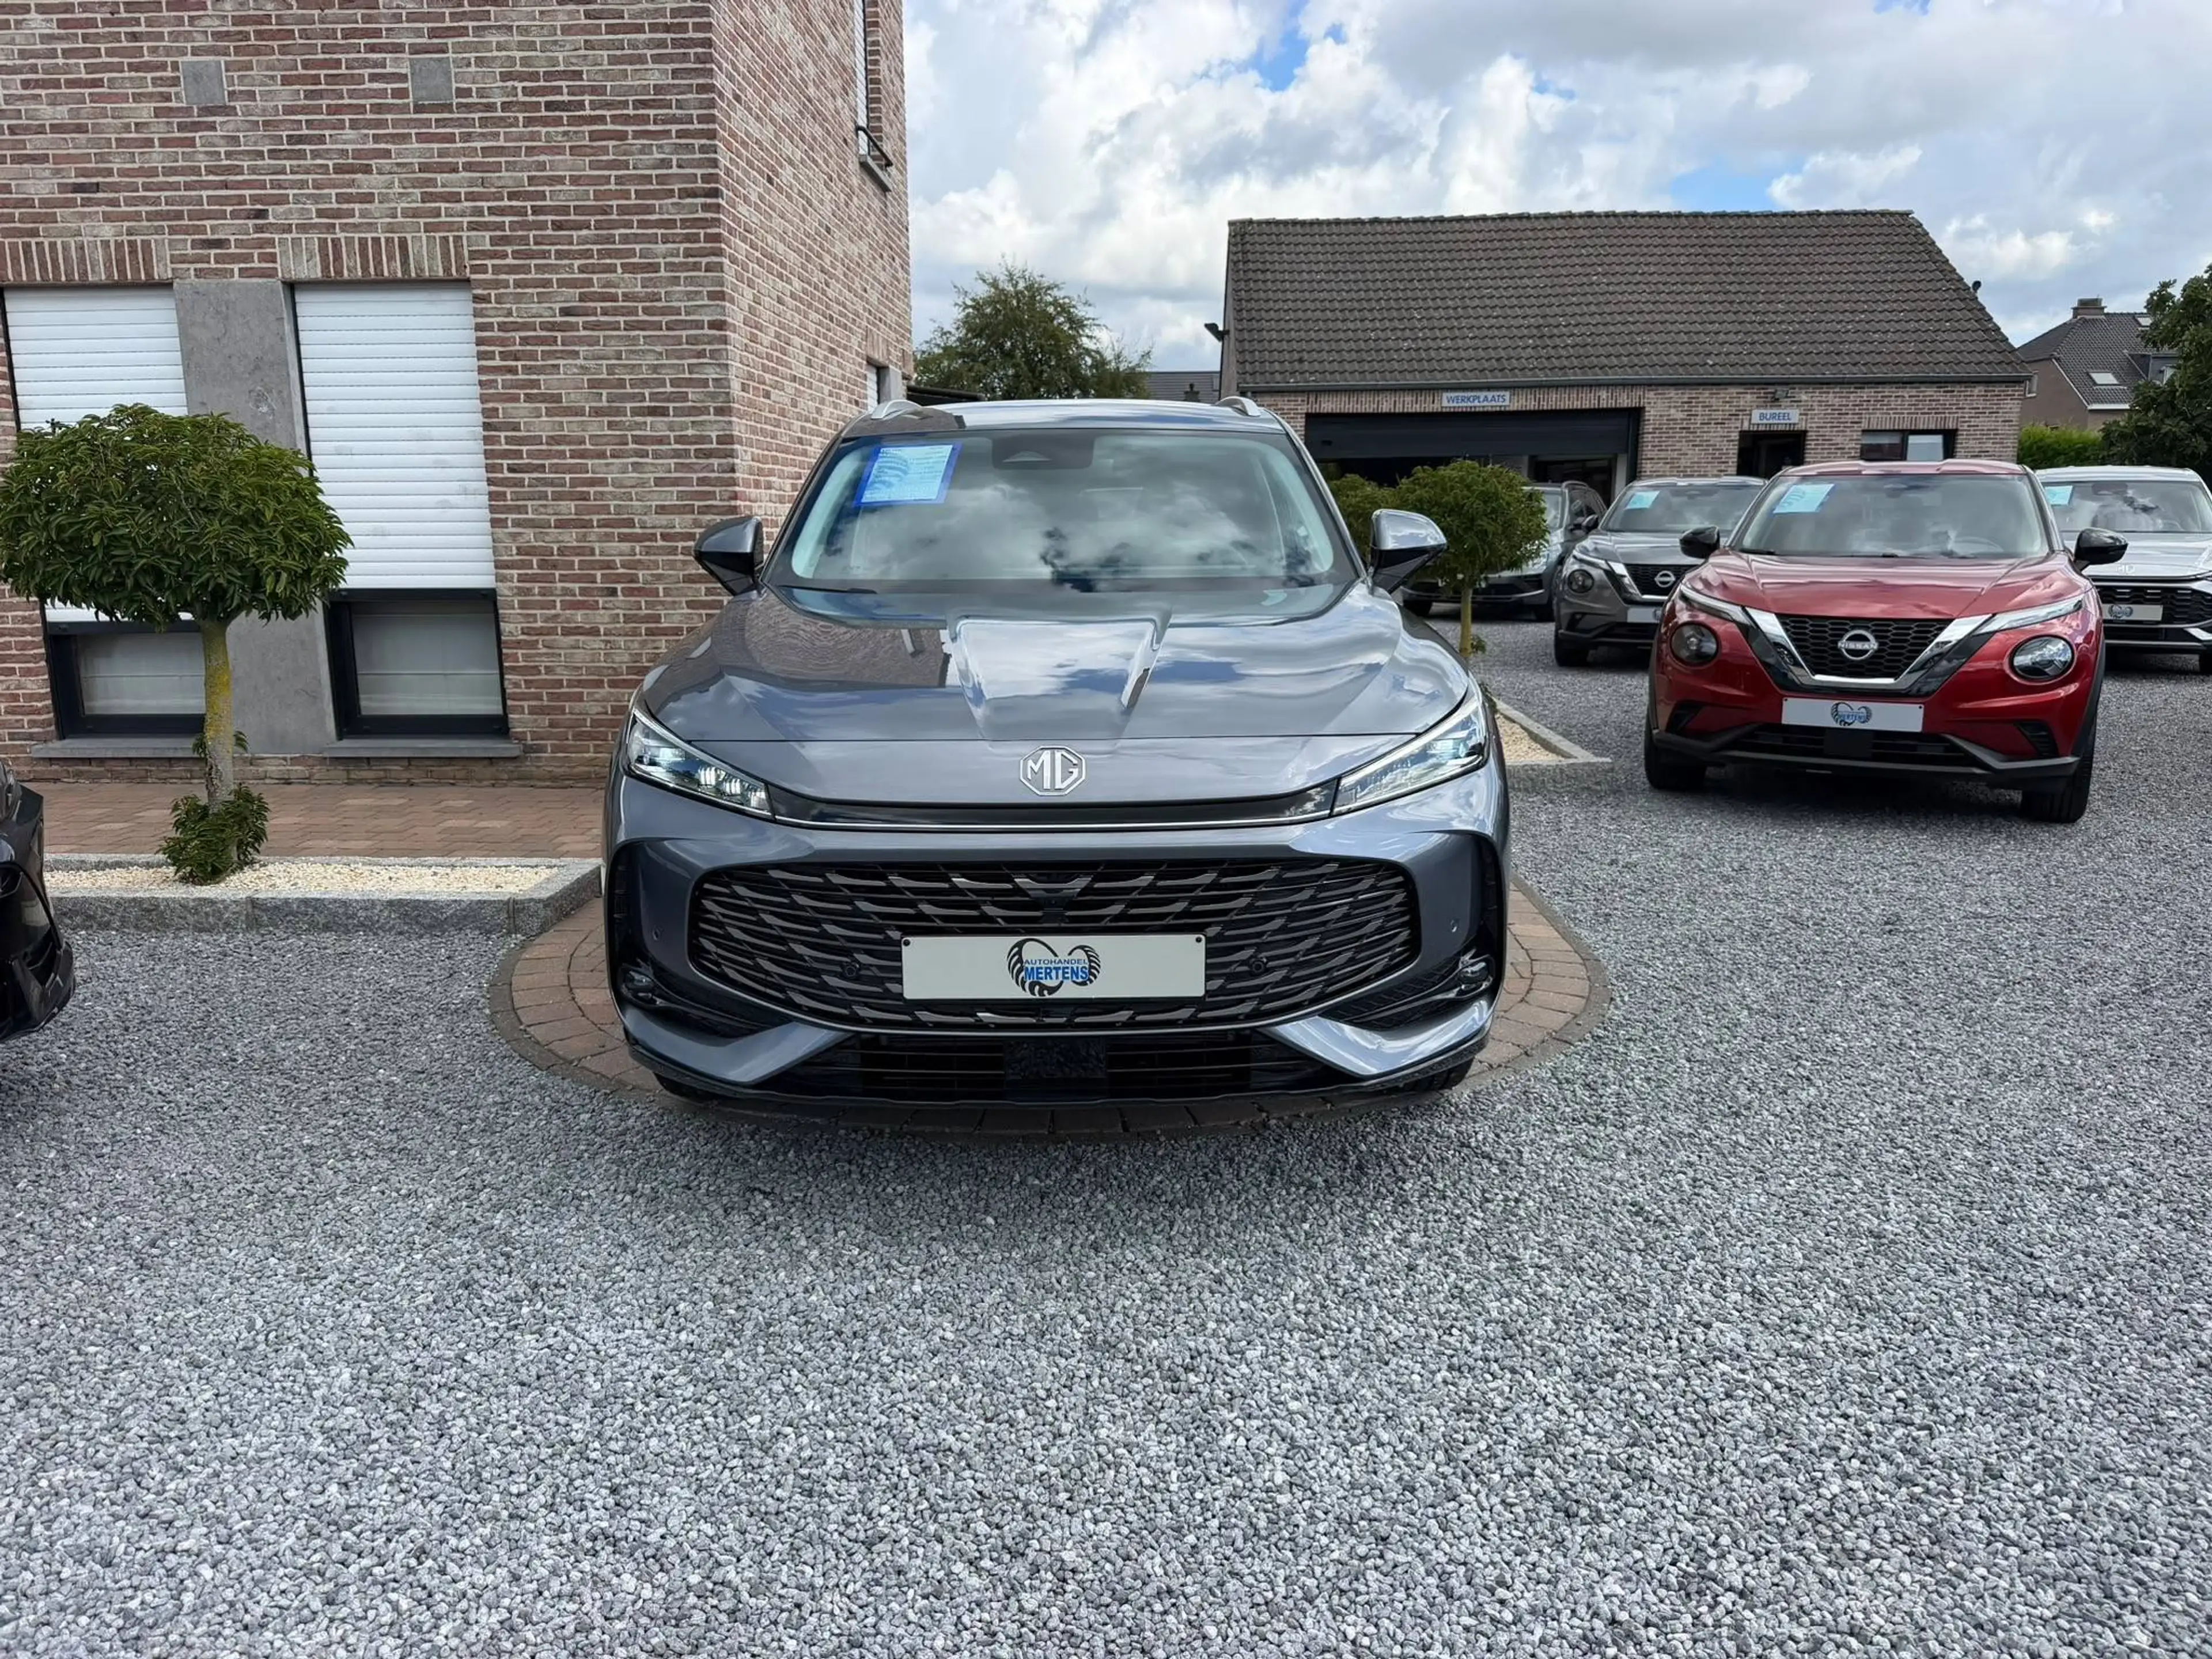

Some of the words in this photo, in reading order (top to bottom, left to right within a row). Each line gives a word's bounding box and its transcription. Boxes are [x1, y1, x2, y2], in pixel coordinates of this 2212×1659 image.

[1446, 395, 1506, 404] WERKPLAATS
[1759, 412, 1792, 421] BUREEL
[1838, 641, 1878, 649] NISSAN
[1027, 750, 1079, 790] MG
[1024, 966, 1089, 980] MERTENS
